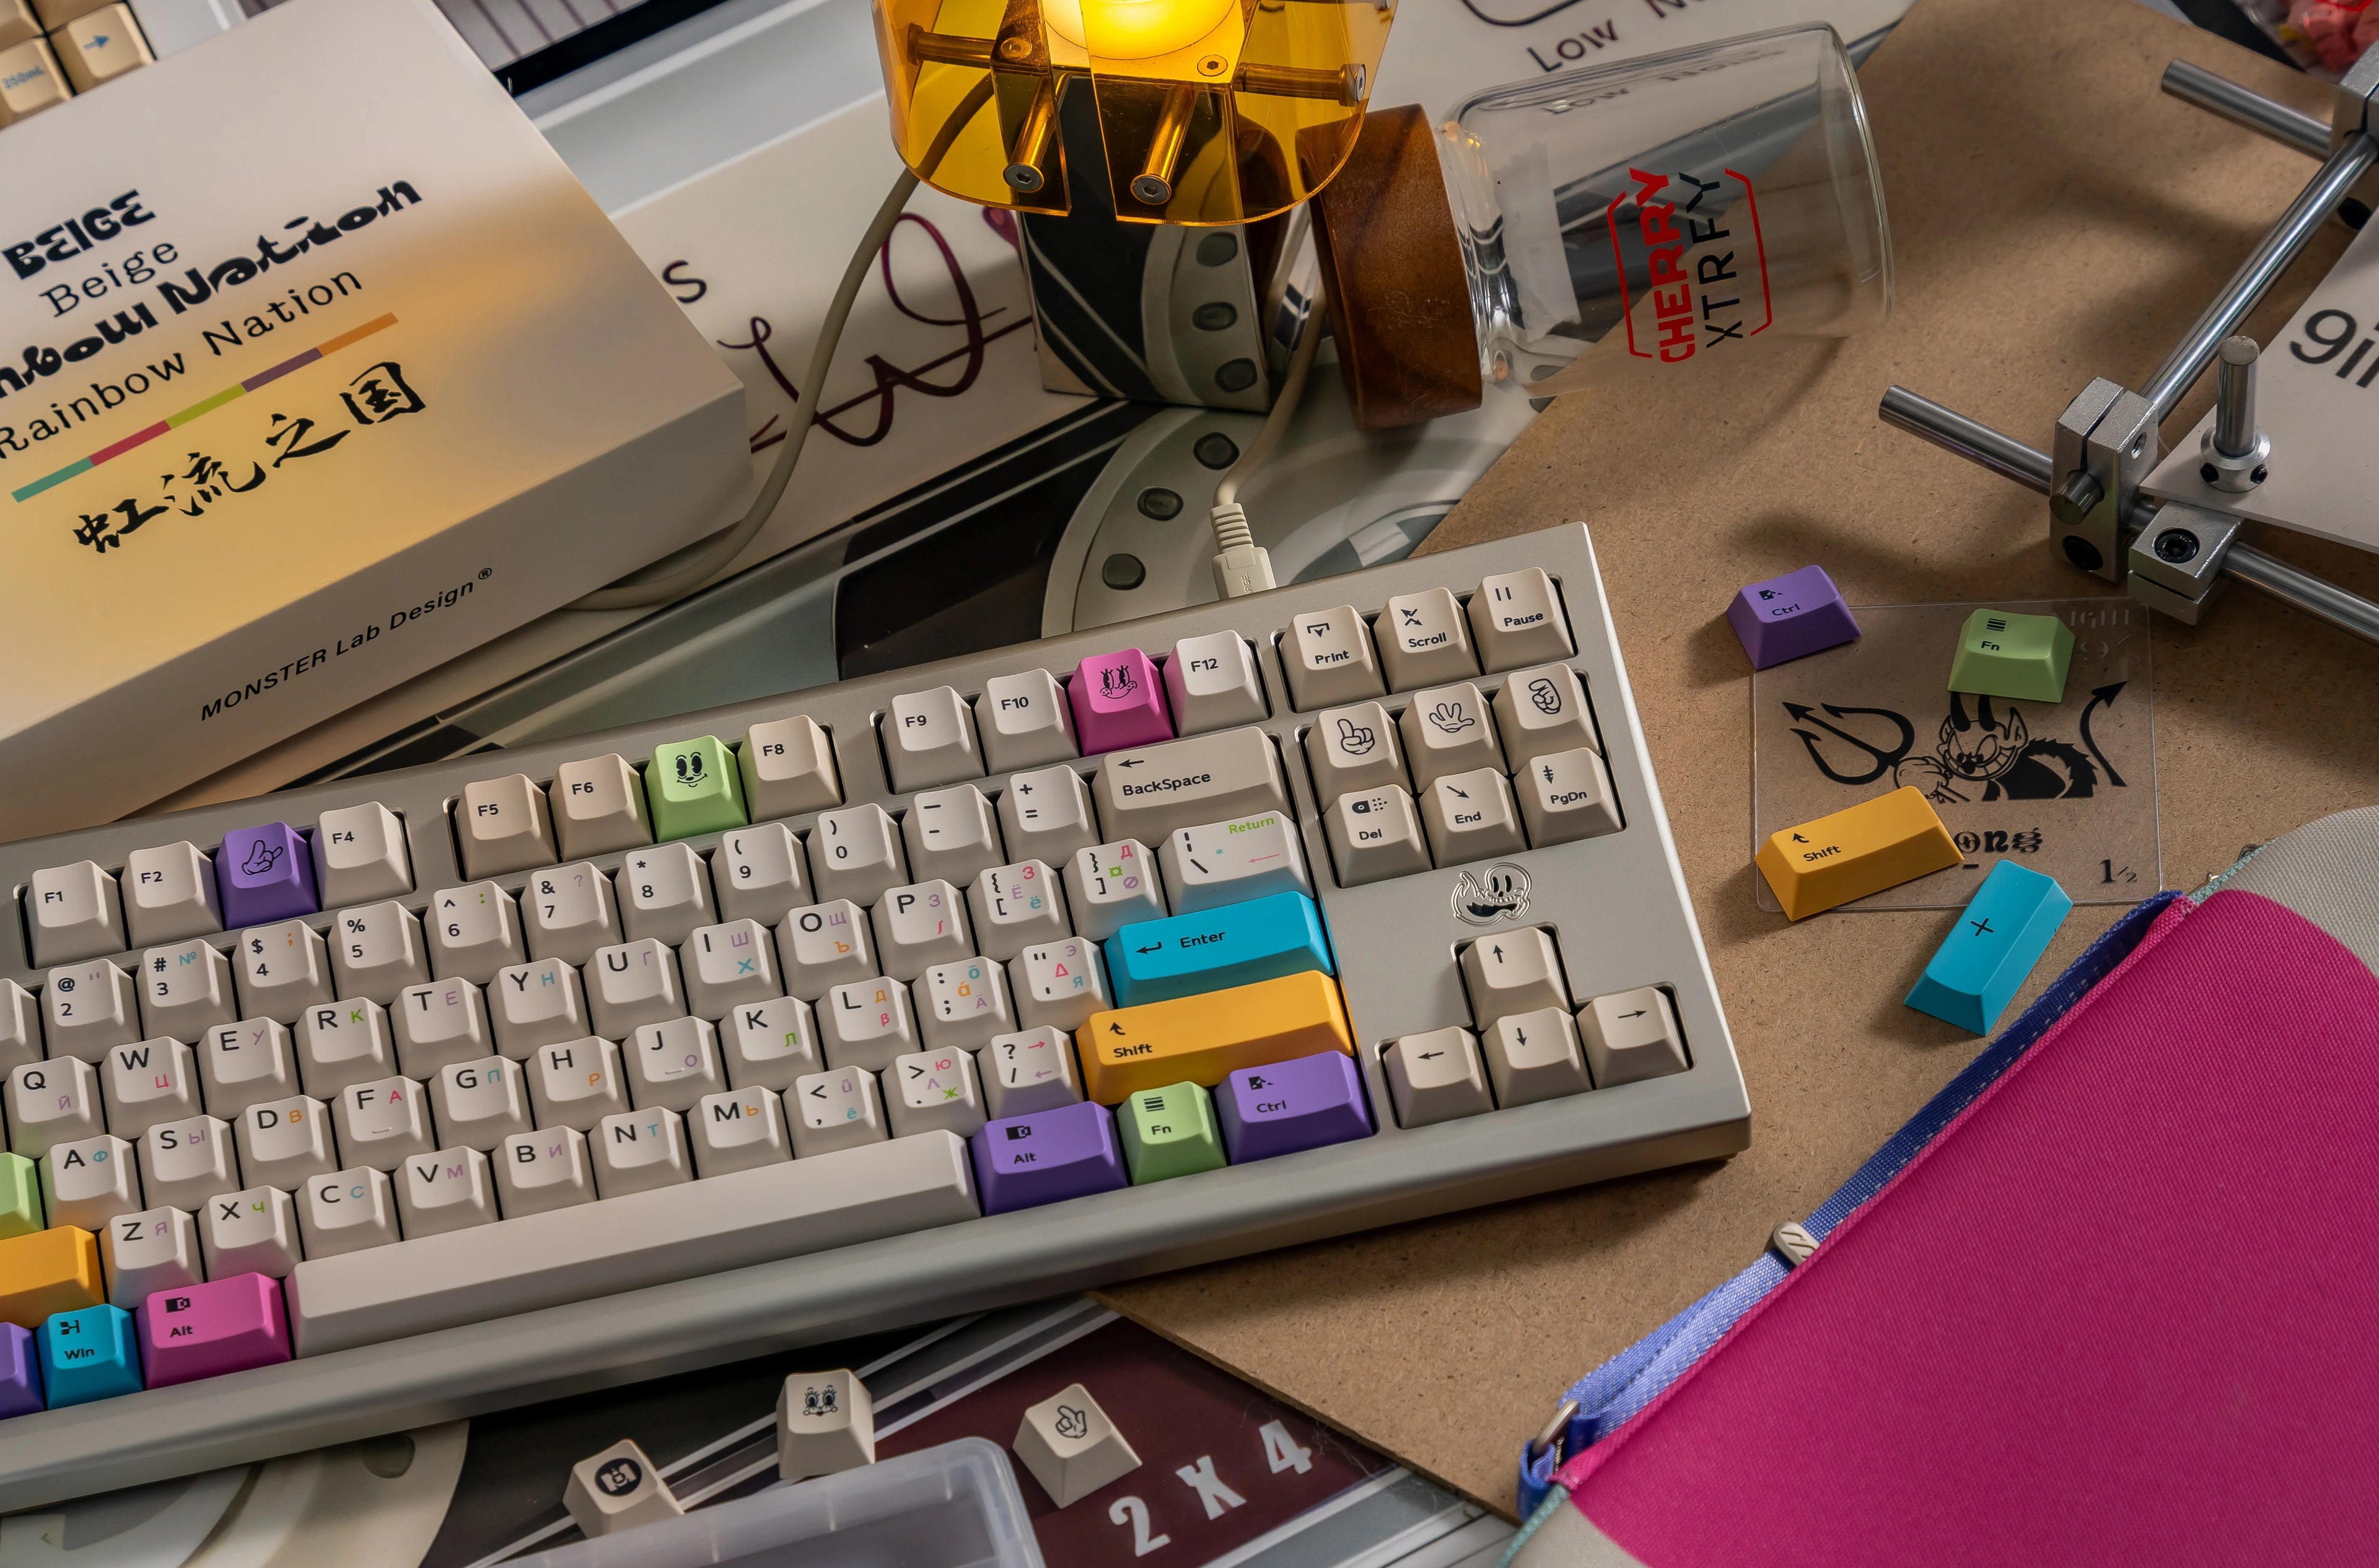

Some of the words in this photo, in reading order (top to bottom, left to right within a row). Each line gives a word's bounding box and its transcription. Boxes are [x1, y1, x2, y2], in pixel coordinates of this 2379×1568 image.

[0, 187, 157, 281] BEIGE
[155, 178, 423, 315] Nation
[1628, 166, 1696, 364] CHERRY
[1678, 170, 1744, 348] XTRFY
[38, 240, 180, 319] Beige
[200, 270, 364, 357] Nation
[1771, 602, 1802, 617] Ctrl
[1504, 611, 1544, 627] Pause
[1408, 632, 1447, 648] Scroll
[1981, 641, 1999, 650] Fn
[1314, 649, 1350, 664] Print
[199, 647, 328, 723] MONSTER
[334, 624, 382, 657] Lab
[1191, 659, 1219, 672] F12
[1001, 697, 1028, 710] F10
[906, 716, 926, 727] F9
[763, 744, 784, 756] F8
[572, 782, 594, 795] F6
[1121, 771, 1212, 797] BackSpace
[1549, 789, 1588, 805] PgDn
[478, 804, 498, 817] F5
[1455, 812, 1481, 823] End
[1229, 817, 1274, 834] Return
[333, 831, 354, 844] F4
[1359, 829, 1382, 840] Del
[1803, 844, 1842, 863] Shift
[141, 872, 162, 883] F2
[740, 865, 751, 878] 9
[541, 881, 555, 894] &
[642, 885, 654, 898] 8
[45, 891, 63, 903] F1
[897, 895, 914, 914] P
[545, 905, 554, 918] 7
[348, 919, 365, 933] %
[449, 924, 460, 937] 6
[800, 913, 822, 932] O
[252, 939, 263, 954] $
[1180, 932, 1225, 948] Enter
[352, 945, 362, 958] 5
[154, 957, 166, 972] #
[256, 963, 269, 976] 4
[607, 952, 628, 971] U
[58, 978, 75, 992] @
[157, 983, 168, 996] 3
[510, 972, 528, 991] Y
[413, 991, 432, 1010] T
[843, 992, 862, 1009] L
[61, 1003, 72, 1016] 2
[317, 1010, 338, 1030] R
[746, 1010, 768, 1030] K
[220, 1031, 239, 1051] E
[651, 1031, 663, 1050] J
[1113, 1043, 1154, 1058] Shift
[120, 1048, 149, 1070] W
[551, 1049, 573, 1070] H
[24, 1071, 46, 1090] Q
[456, 1069, 477, 1088] G
[357, 1090, 374, 1110] F
[1257, 1100, 1286, 1113] Ctrl
[257, 1110, 278, 1129] D
[714, 1102, 740, 1121] M
[615, 1124, 636, 1143] N
[1152, 1126, 1171, 1135] Fn
[160, 1131, 177, 1149] S
[64, 1150, 85, 1169] A
[516, 1145, 535, 1163] B
[1014, 1153, 1036, 1164] Alt
[417, 1165, 438, 1183] V
[320, 1186, 340, 1203] C
[220, 1202, 240, 1220] X
[122, 1222, 143, 1241] Z
[170, 1326, 193, 1338] Alt
[64, 1348, 94, 1360] Win
[1108, 1494, 1172, 1559] 2
[1174, 1454, 1246, 1521] X
[1258, 1418, 1313, 1476] 4
